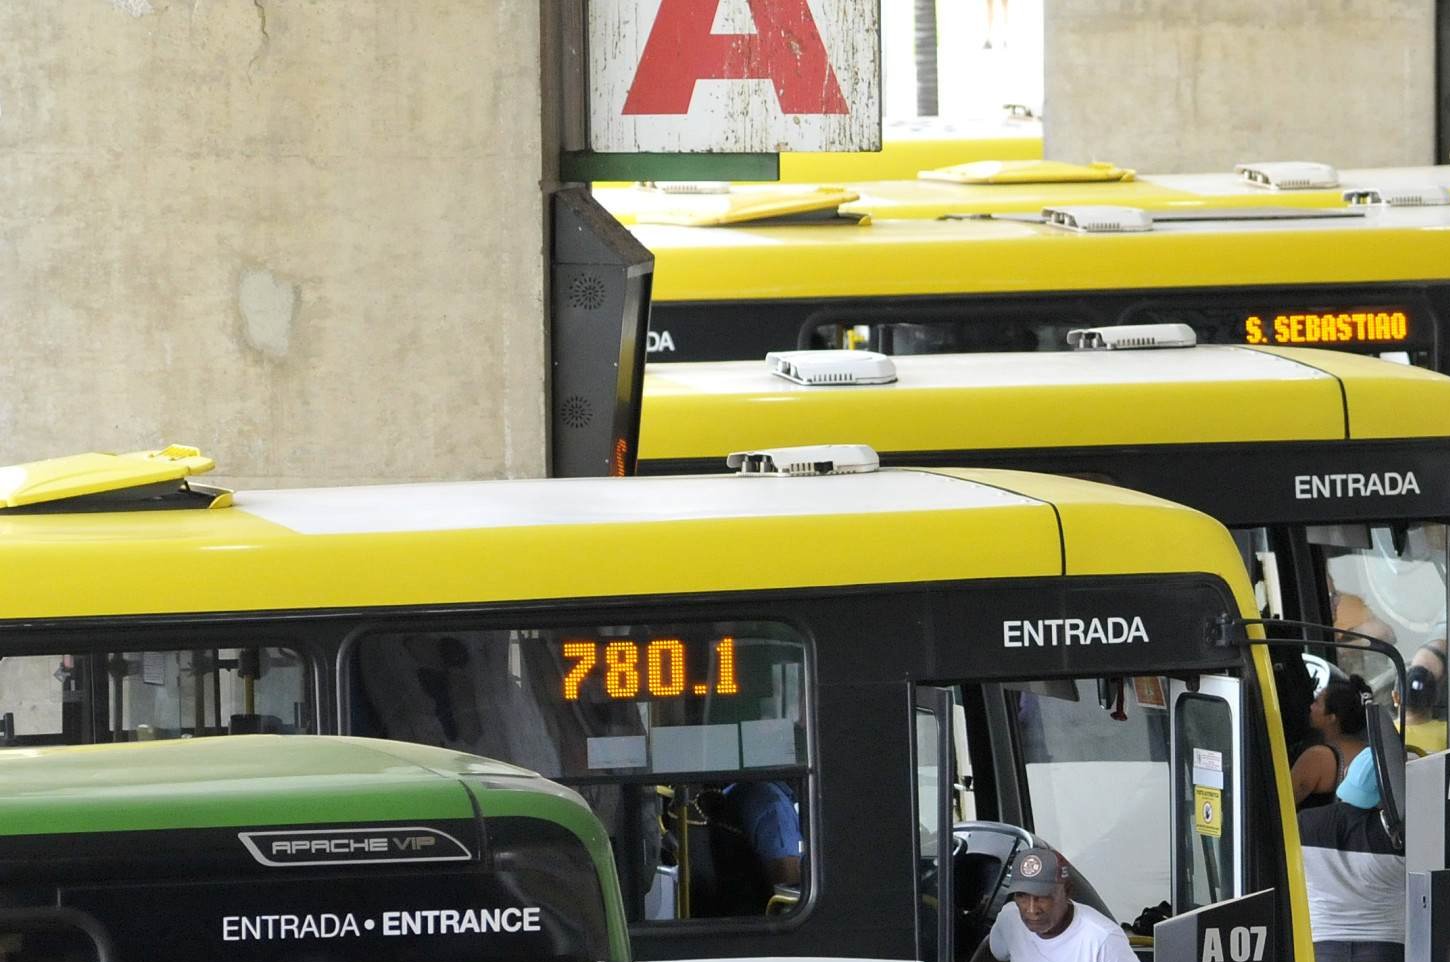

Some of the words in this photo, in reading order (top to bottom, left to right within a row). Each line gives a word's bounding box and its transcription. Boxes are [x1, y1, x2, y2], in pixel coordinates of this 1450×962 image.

[621, 0, 850, 115] A
[1245, 315, 1268, 344] S.
[1274, 311, 1408, 343] SEBASTIAO
[1294, 471, 1421, 499] ENTRADA
[1003, 616, 1150, 648] ENTRADA
[564, 637, 738, 700] 780.1
[272, 838, 388, 855] APACHE
[392, 836, 436, 850] VIP
[223, 912, 361, 941] ENTRADA
[382, 907, 542, 936] ENTRANCE
[1229, 925, 1267, 962] 07
